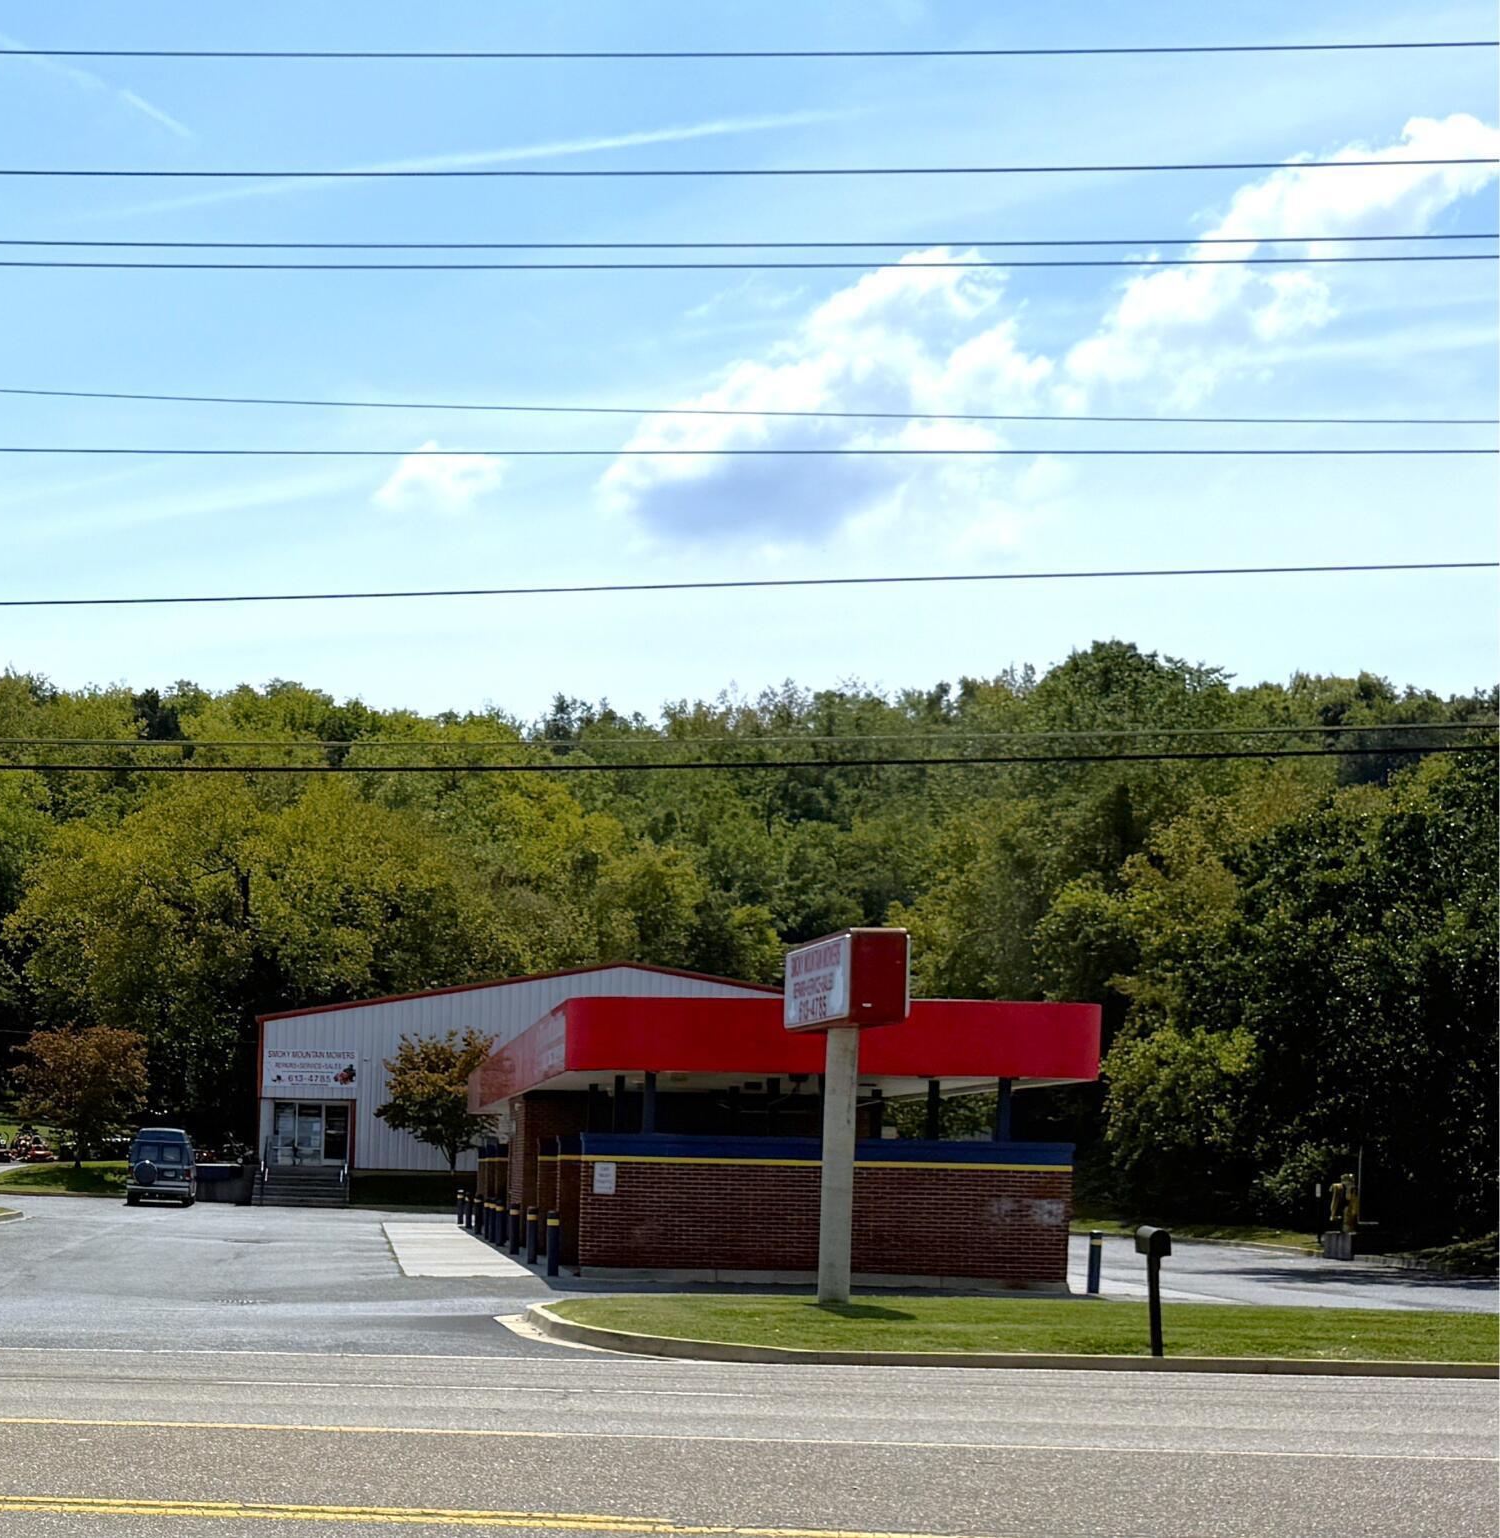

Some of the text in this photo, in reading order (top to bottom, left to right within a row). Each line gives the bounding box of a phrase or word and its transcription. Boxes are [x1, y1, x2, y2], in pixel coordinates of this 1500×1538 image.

[268, 1050, 356, 1060] SMOKY MOUNTAIN MOWERS
[288, 1074, 332, 1083] 613-4785
